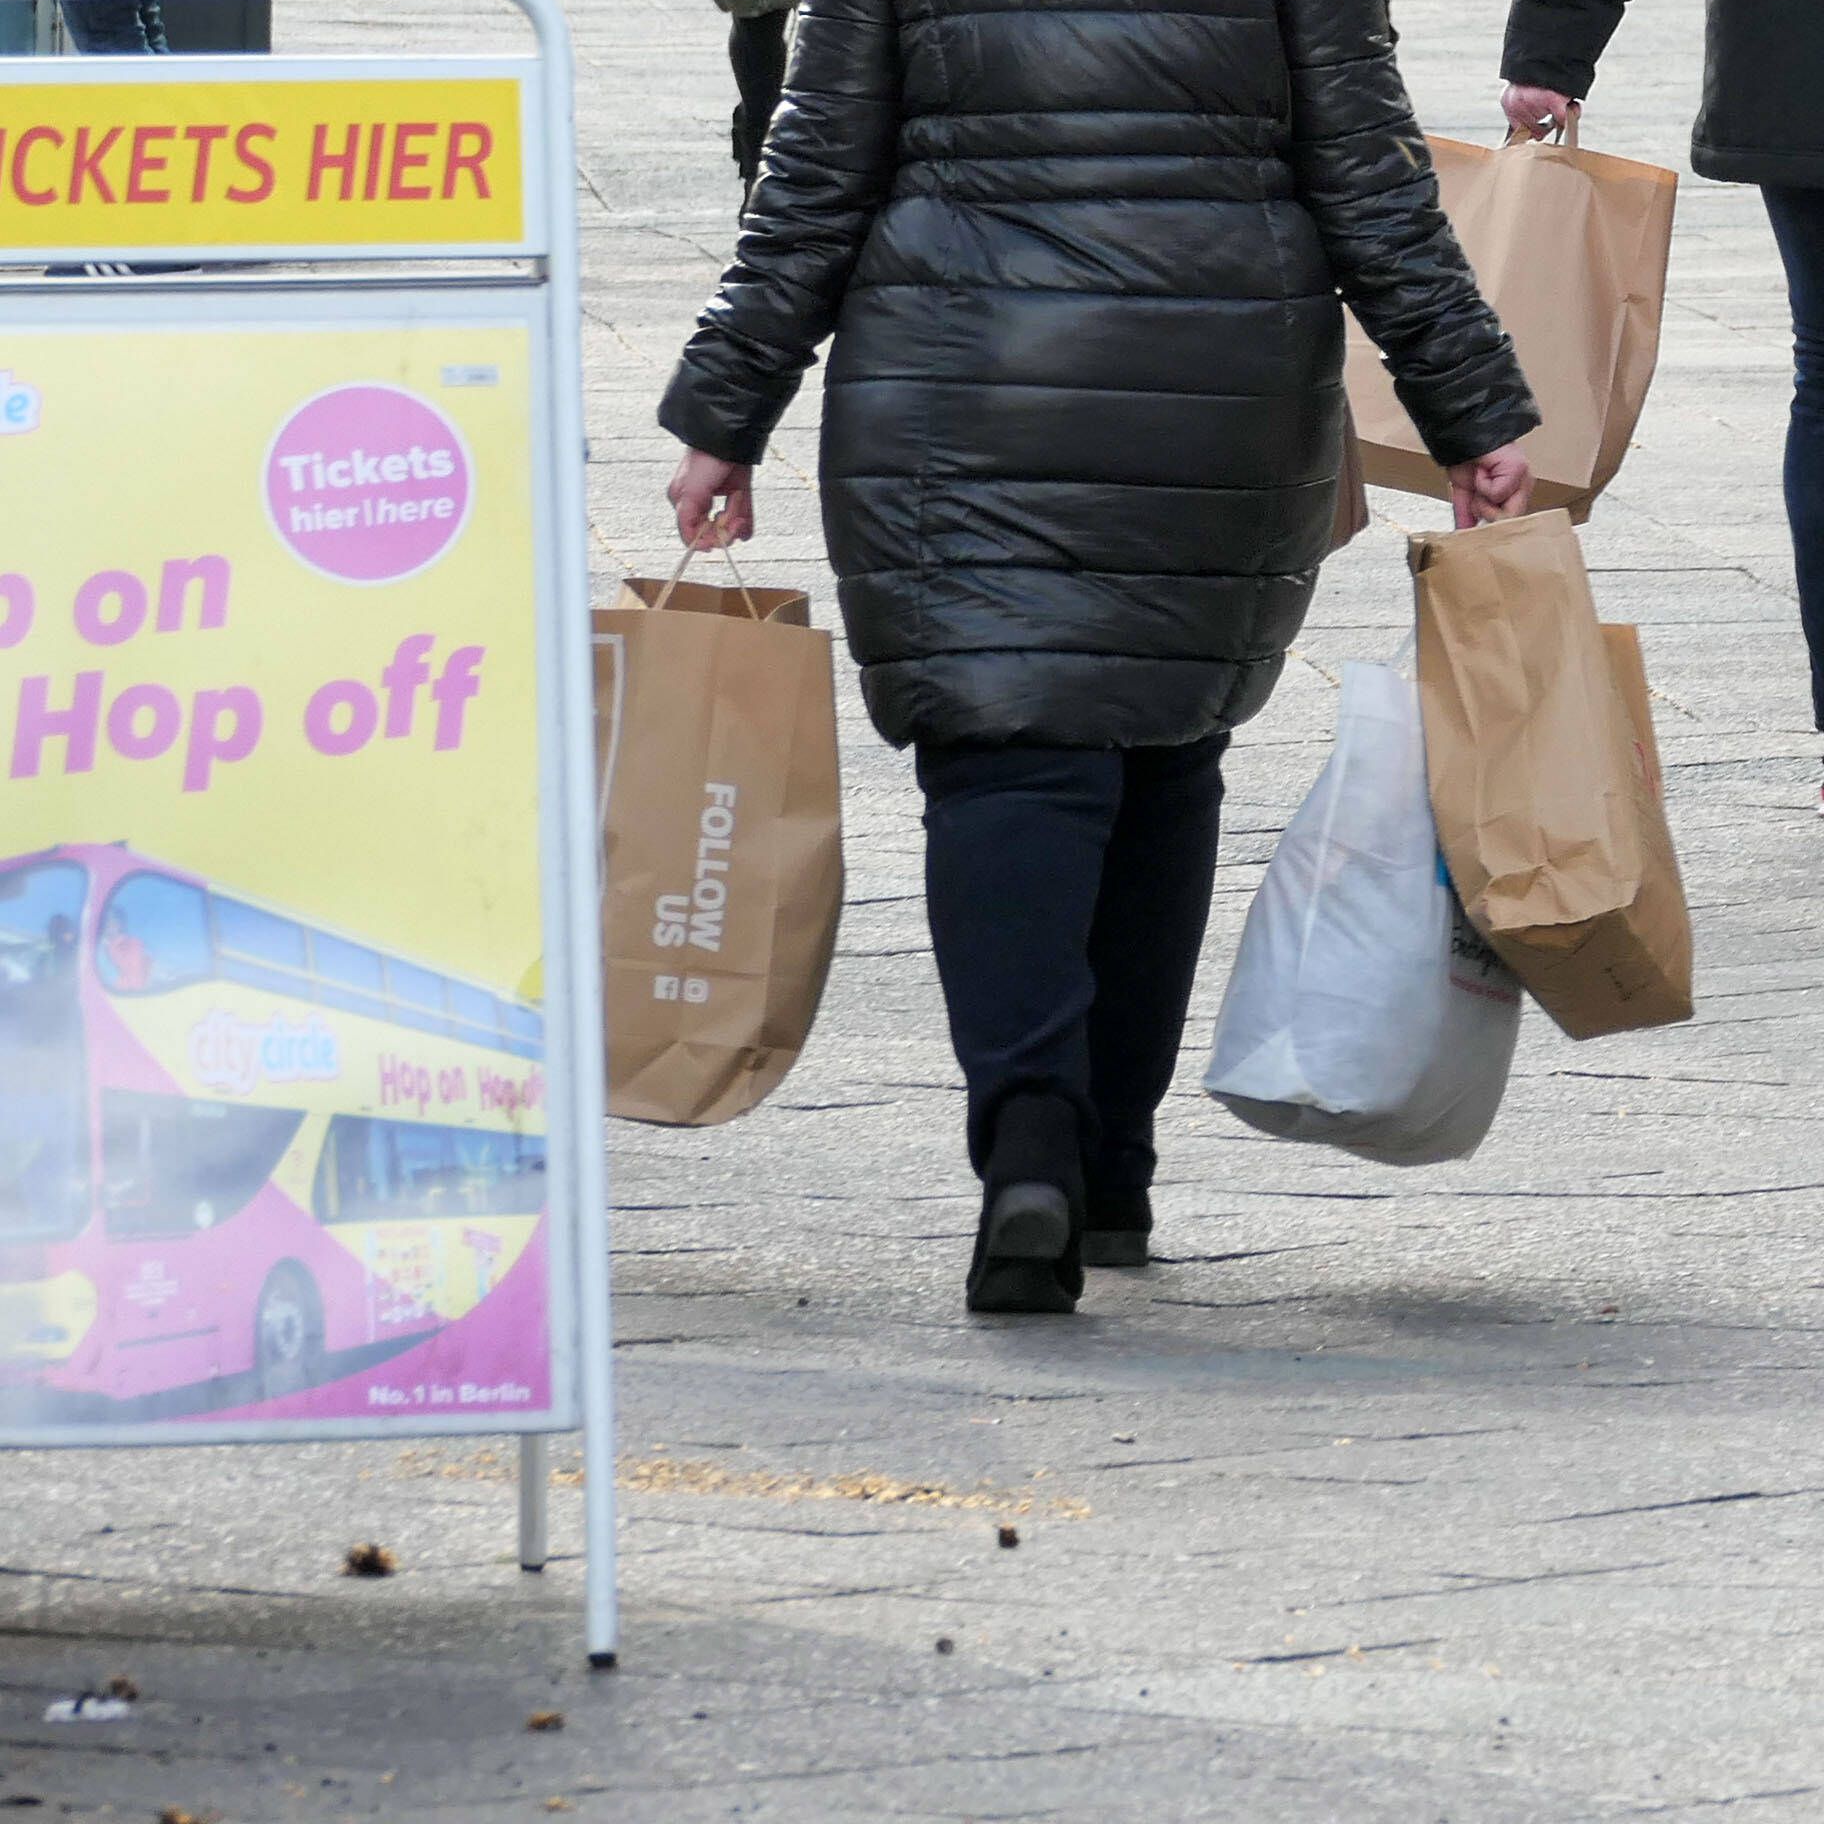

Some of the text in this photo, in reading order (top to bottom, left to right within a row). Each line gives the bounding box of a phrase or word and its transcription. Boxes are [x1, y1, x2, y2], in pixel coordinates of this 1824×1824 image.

[306, 121, 493, 203] HIER
[279, 445, 456, 493] Tickets
[73, 552, 232, 646] on
[10, 634, 486, 792] Hop off
[695, 781, 737, 954] FOLLOW
[651, 893, 691, 949] US
[430, 1383, 454, 1404] in
[458, 1382, 531, 1405] Berlin
